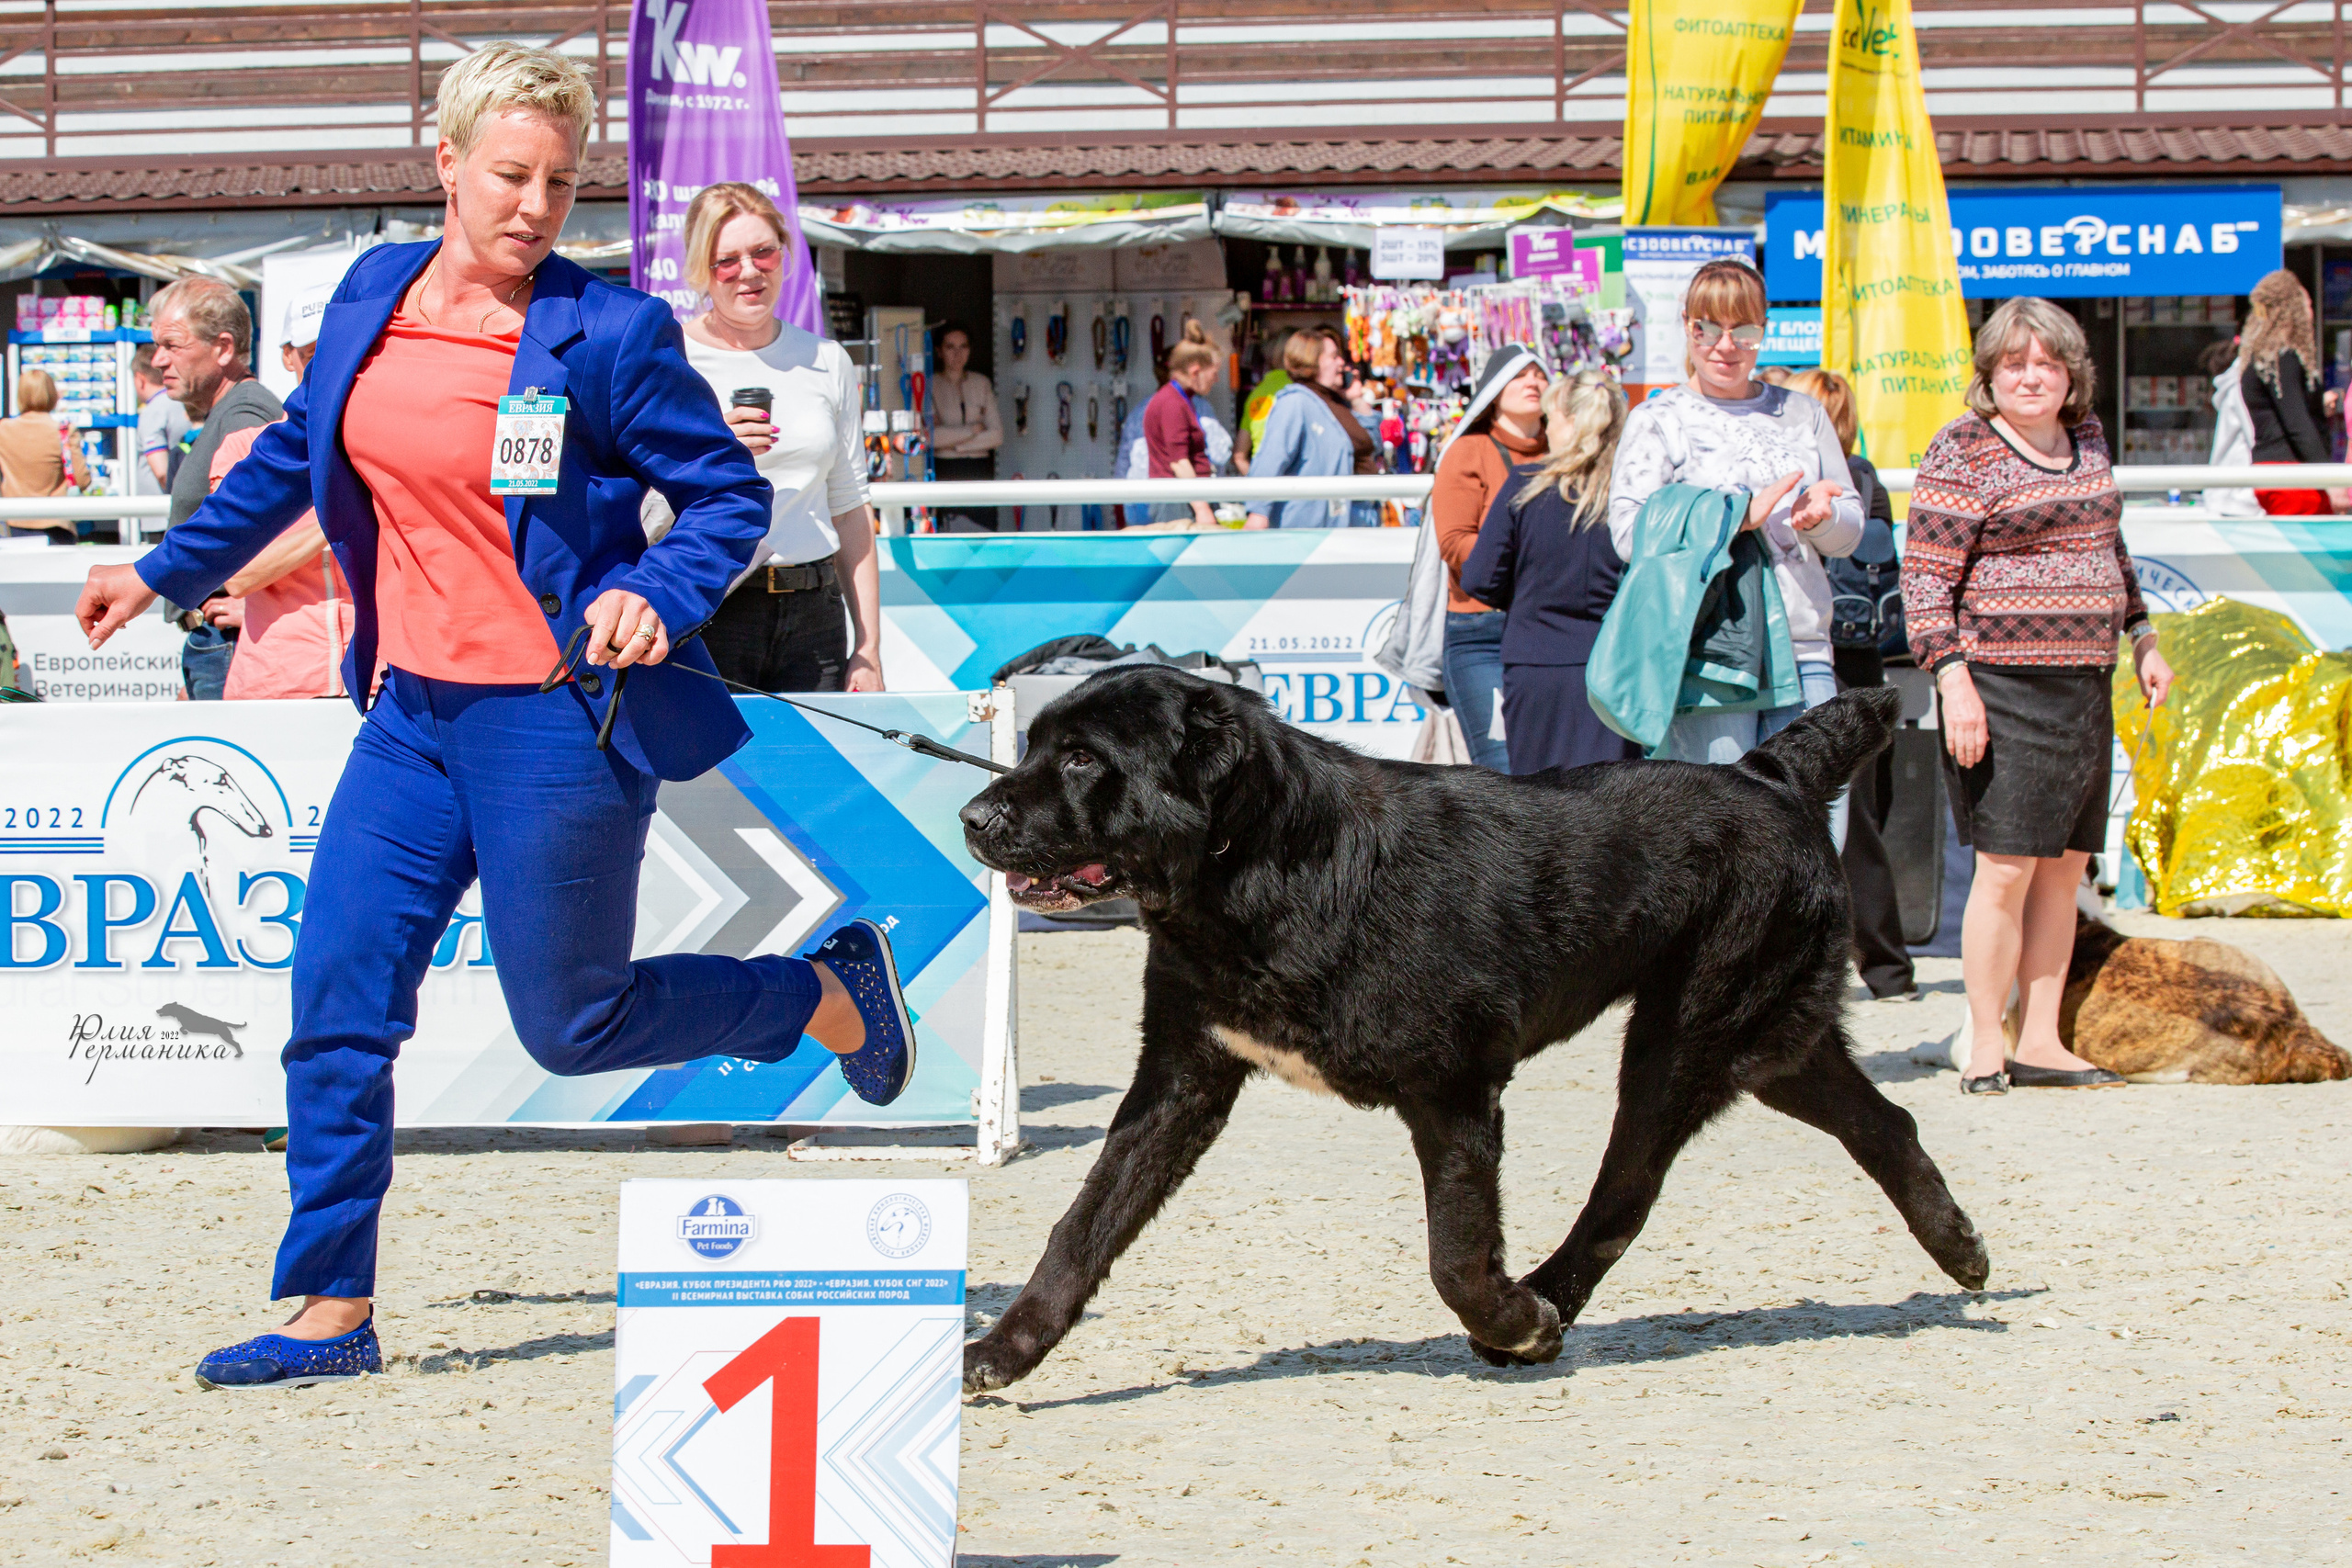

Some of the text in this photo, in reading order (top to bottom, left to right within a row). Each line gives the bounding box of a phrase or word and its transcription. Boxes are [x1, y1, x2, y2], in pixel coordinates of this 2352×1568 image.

[1674, 17, 1785, 40] ФИТОАПТЕКА
[1982, 263, 2050, 279] ЗАБОТЯСЬ
[2052, 263, 2063, 277] О
[2064, 262, 2131, 277] ГЛАВНОМ
[1852, 276, 1955, 301] ИТОАПТЕКА
[1882, 375, 1964, 395] ПИТАНИЕ
[508, 403, 554, 413] ЕВРАЗИЯ
[500, 437, 553, 465] 0878
[508, 479, 538, 488] 21.05.2022
[1250, 637, 1353, 650] 21.05.2022
[683, 1219, 749, 1235] Farmina
[697, 1242, 733, 1250] Pet Foods
[635, 1280, 681, 1290] «ЕВРАЗИЯ.
[683, 1280, 712, 1290] КУБОК
[714, 1280, 771, 1290] ПРЕЗИДЕНТА
[773, 1280, 792, 1289] РКФ
[794, 1280, 817, 1288] 2022»
[825, 1279, 872, 1288] «ЕВРАЗИЯ.
[874, 1279, 904, 1288] КУБОК
[906, 1279, 923, 1288] СНГ
[925, 1279, 949, 1288] 2022»
[681, 1292, 734, 1301] ВСЕМИРНАЯ
[736, 1291, 783, 1301] ВЫСТАВКА
[785, 1291, 814, 1300] СОБАК
[816, 1289, 876, 1300] РОССИЙСКИХ
[878, 1290, 910, 1300] ПОРОД
[702, 1316, 871, 1568] 1
